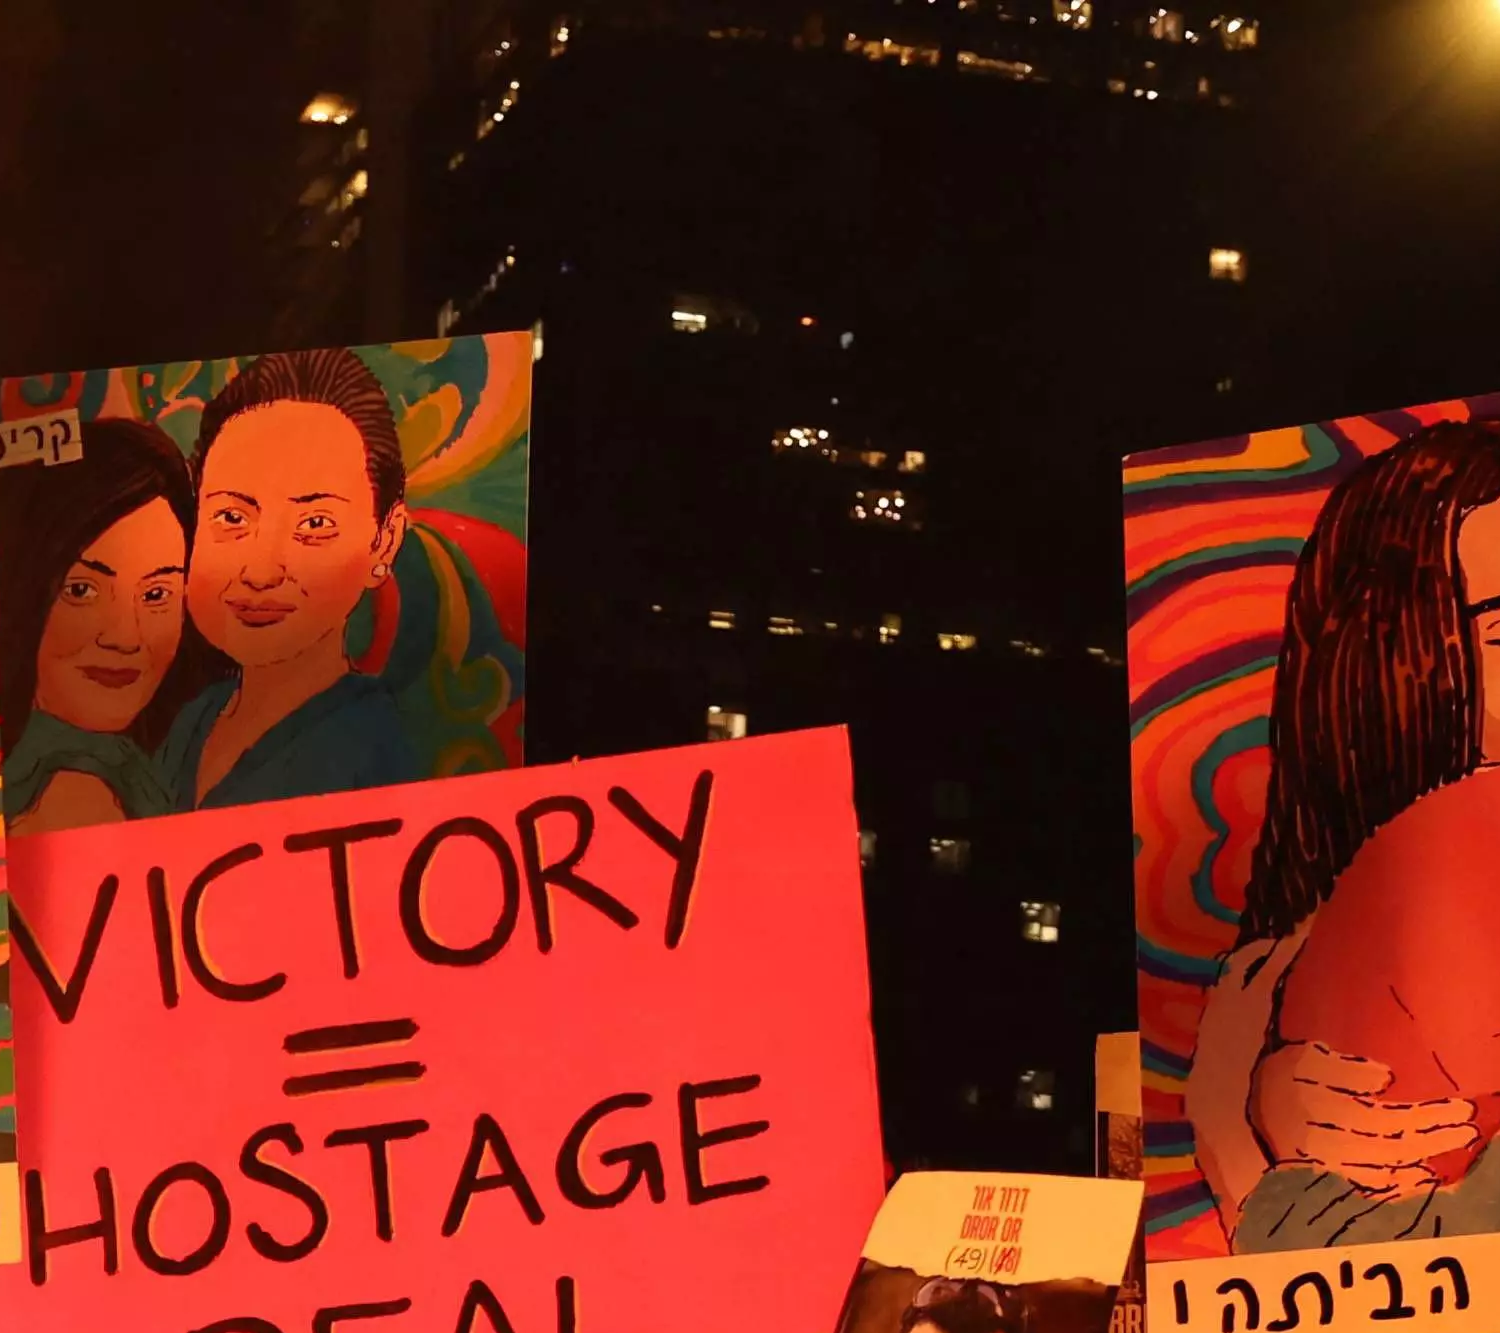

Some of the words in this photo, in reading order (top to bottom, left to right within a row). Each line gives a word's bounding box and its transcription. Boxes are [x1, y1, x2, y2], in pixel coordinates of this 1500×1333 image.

[6, 770, 714, 1023] VICTORY
[25, 1073, 770, 1286] HOSTAGE
[999, 1216, 1024, 1243] OR
